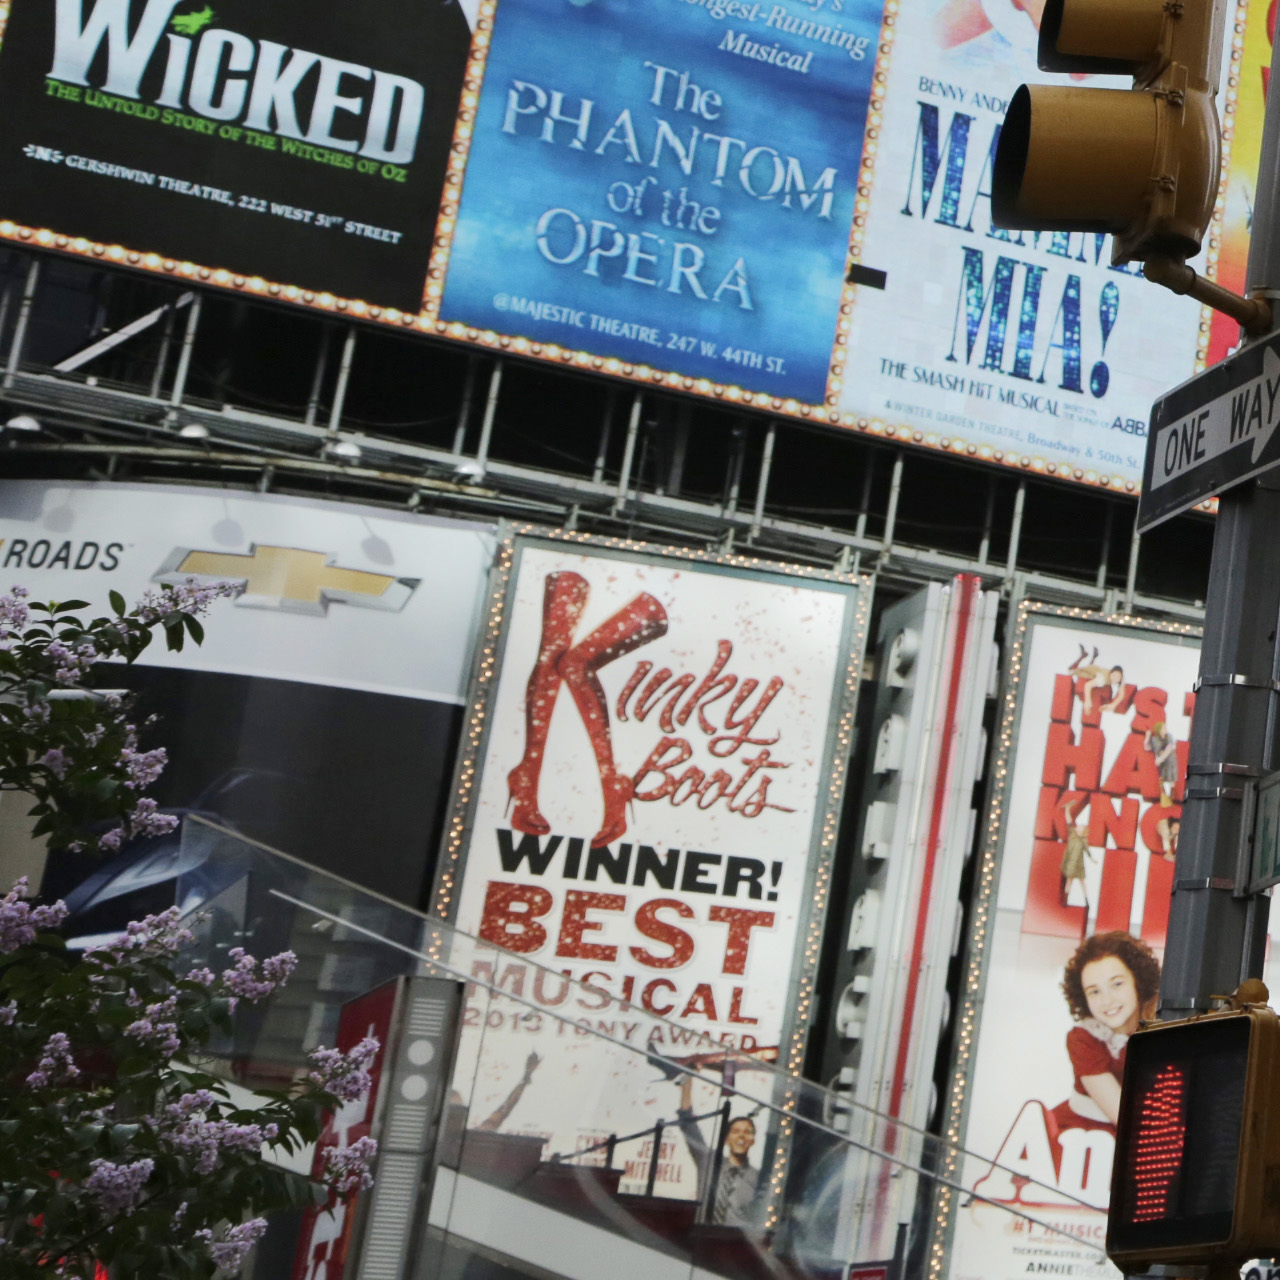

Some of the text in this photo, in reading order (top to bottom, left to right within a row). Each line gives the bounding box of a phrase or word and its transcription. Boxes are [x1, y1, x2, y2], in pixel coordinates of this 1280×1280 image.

[717, 29, 813, 74] Musical
[644, 60, 723, 120] The
[919, 75, 966, 103] BENNY
[44, 78, 408, 182] THE UNTOLD STORY OF THE WITCHES OF OZ
[501, 79, 838, 222] PHANTOM
[65, 154, 155, 186] GERSHWIN
[157, 175, 235, 207] THEATRE,
[238, 195, 267, 213] 222
[270, 202, 313, 224] WEST
[344, 221, 403, 245] STREET
[606, 176, 722, 234] of the
[536, 207, 755, 312] OPERA
[589, 315, 663, 348] THEATRE,
[666, 332, 697, 353] 247
[700, 341, 717, 359] W.
[722, 346, 763, 369] 44TH
[765, 357, 787, 375] ST.
[945, 246, 1120, 399] MIA!
[880, 357, 908, 380] THE
[912, 366, 965, 394] SMASH
[998, 385, 1060, 418] MUSICAL
[894, 402, 932, 418] WINTER
[935, 410, 975, 429] GARDEN
[1027, 432, 1081, 455] Broadway
[1085, 445, 1093, 458] &
[1096, 450, 1123, 464] 50th
[1110, 416, 1148, 438] ABB
[1164, 410, 1210, 476] ONE
[3, 539, 123, 571] ROADS
[504, 570, 783, 848] Kinky
[633, 736, 797, 818] Boots
[496, 828, 783, 902] WINNER!
[478, 880, 776, 975] BEST
[464, 960, 758, 1025] MUSICAL
[462, 1007, 543, 1032] 2013
[558, 1020, 641, 1045] TONY
[623, 1160, 682, 1183] MITHELL
[637, 1140, 676, 1161] JERY
